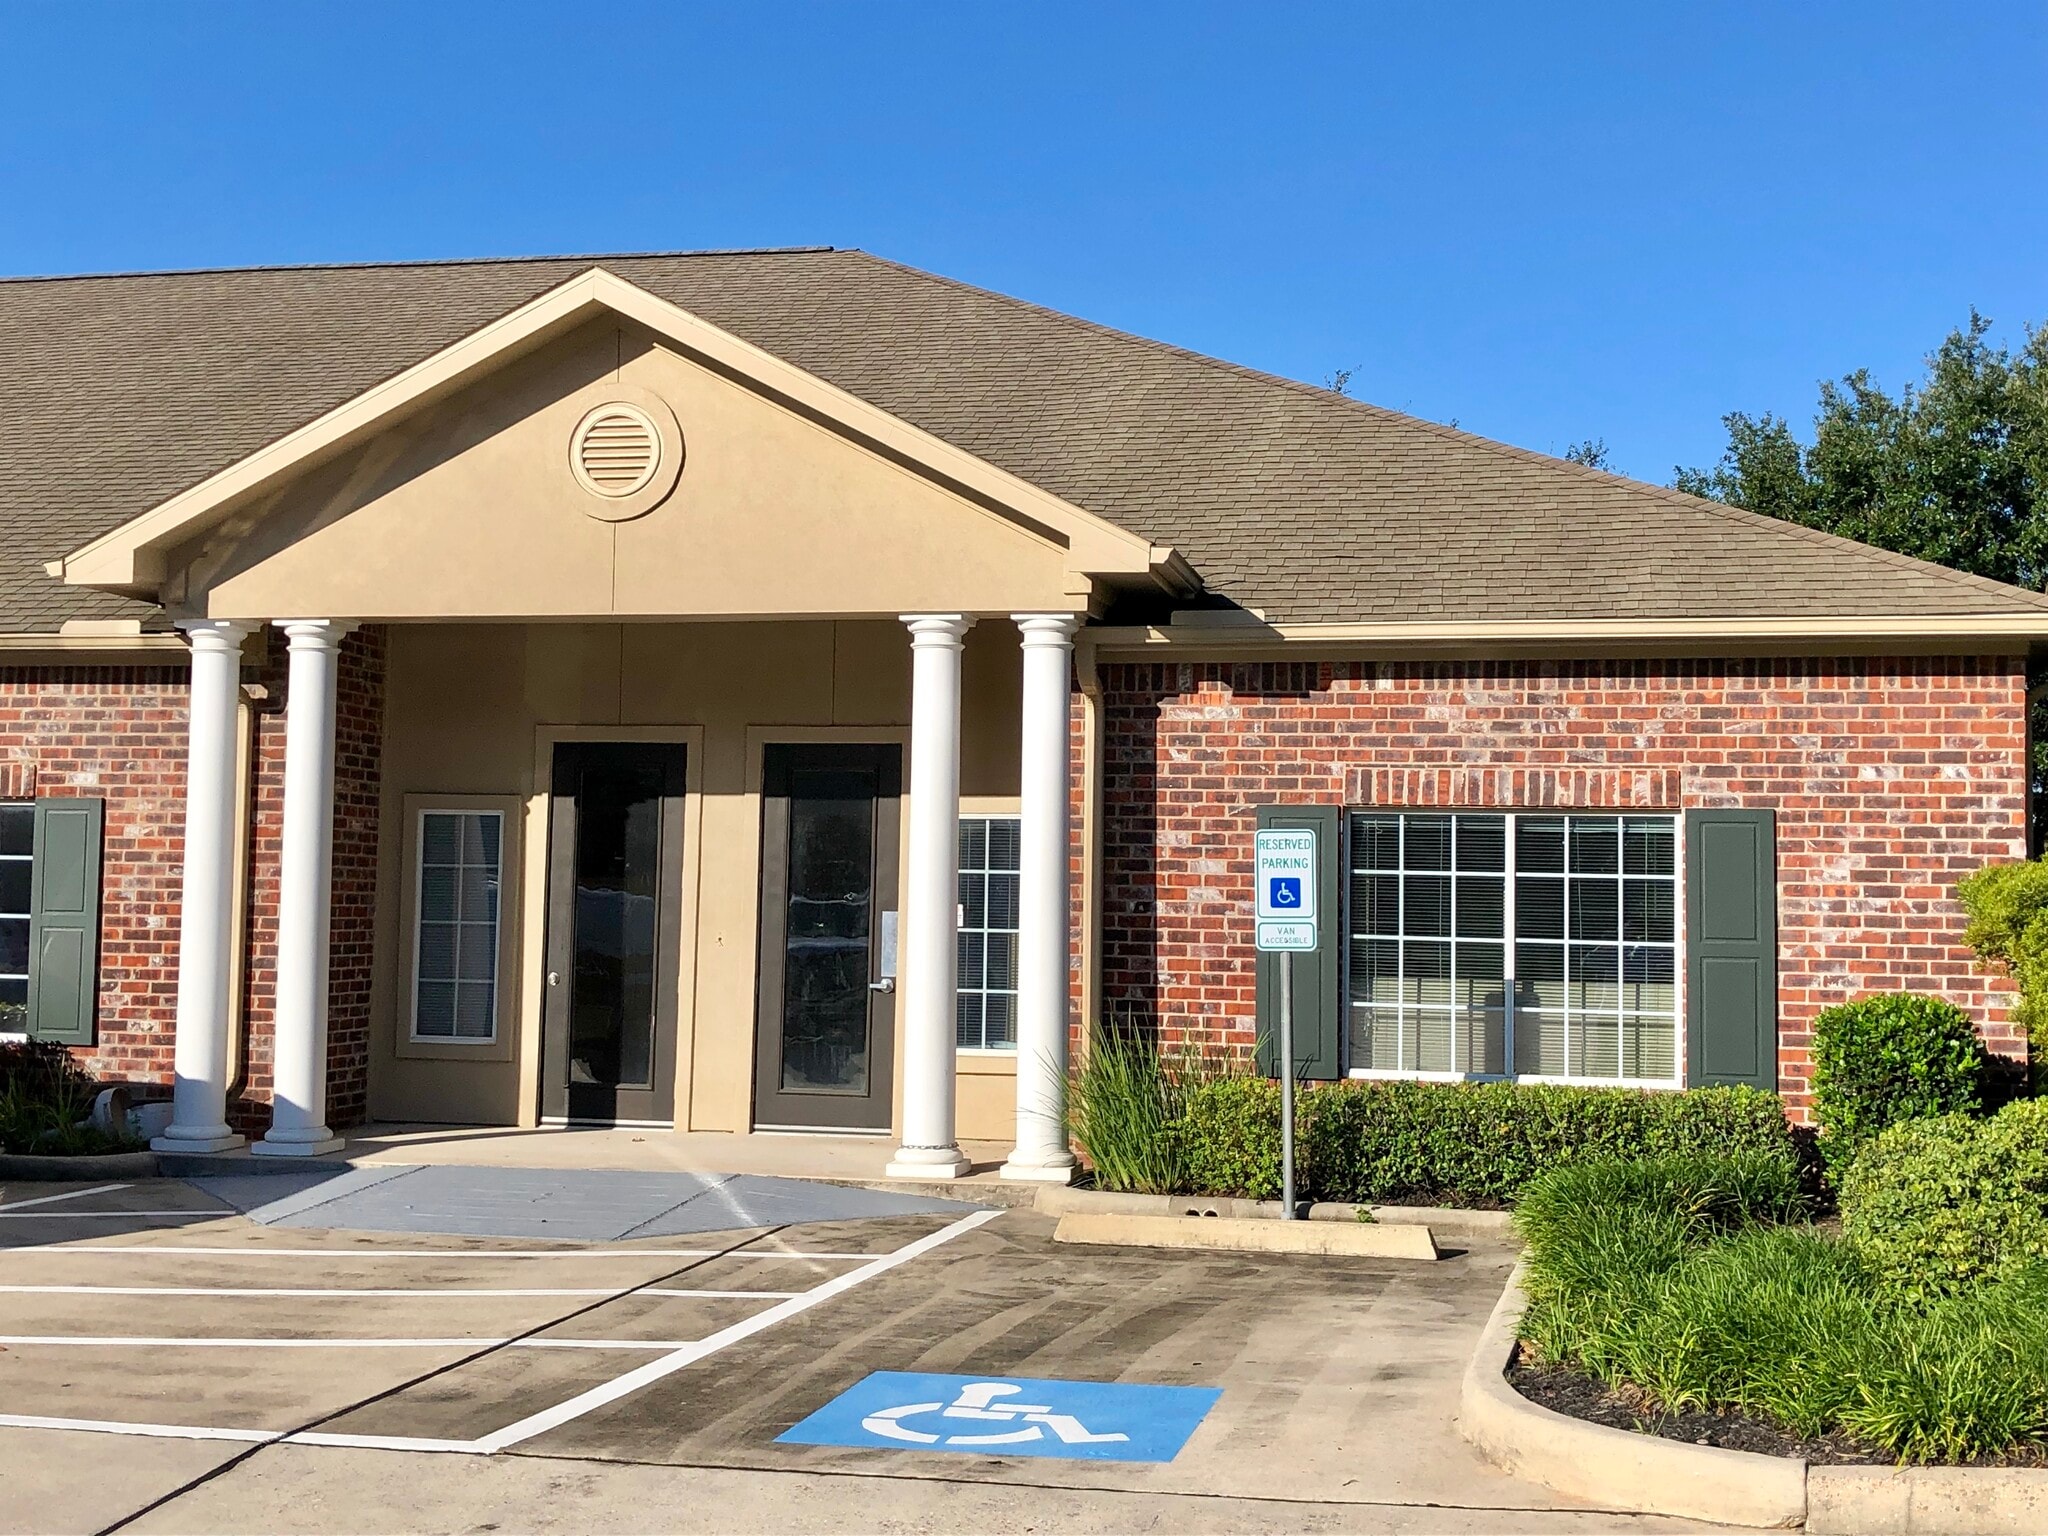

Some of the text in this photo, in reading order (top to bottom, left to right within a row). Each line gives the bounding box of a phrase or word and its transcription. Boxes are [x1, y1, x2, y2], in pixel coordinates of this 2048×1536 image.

[1259, 838, 1311, 850] RESERVED
[1262, 857, 1309, 869] PARKING
[1277, 927, 1295, 935] VAN
